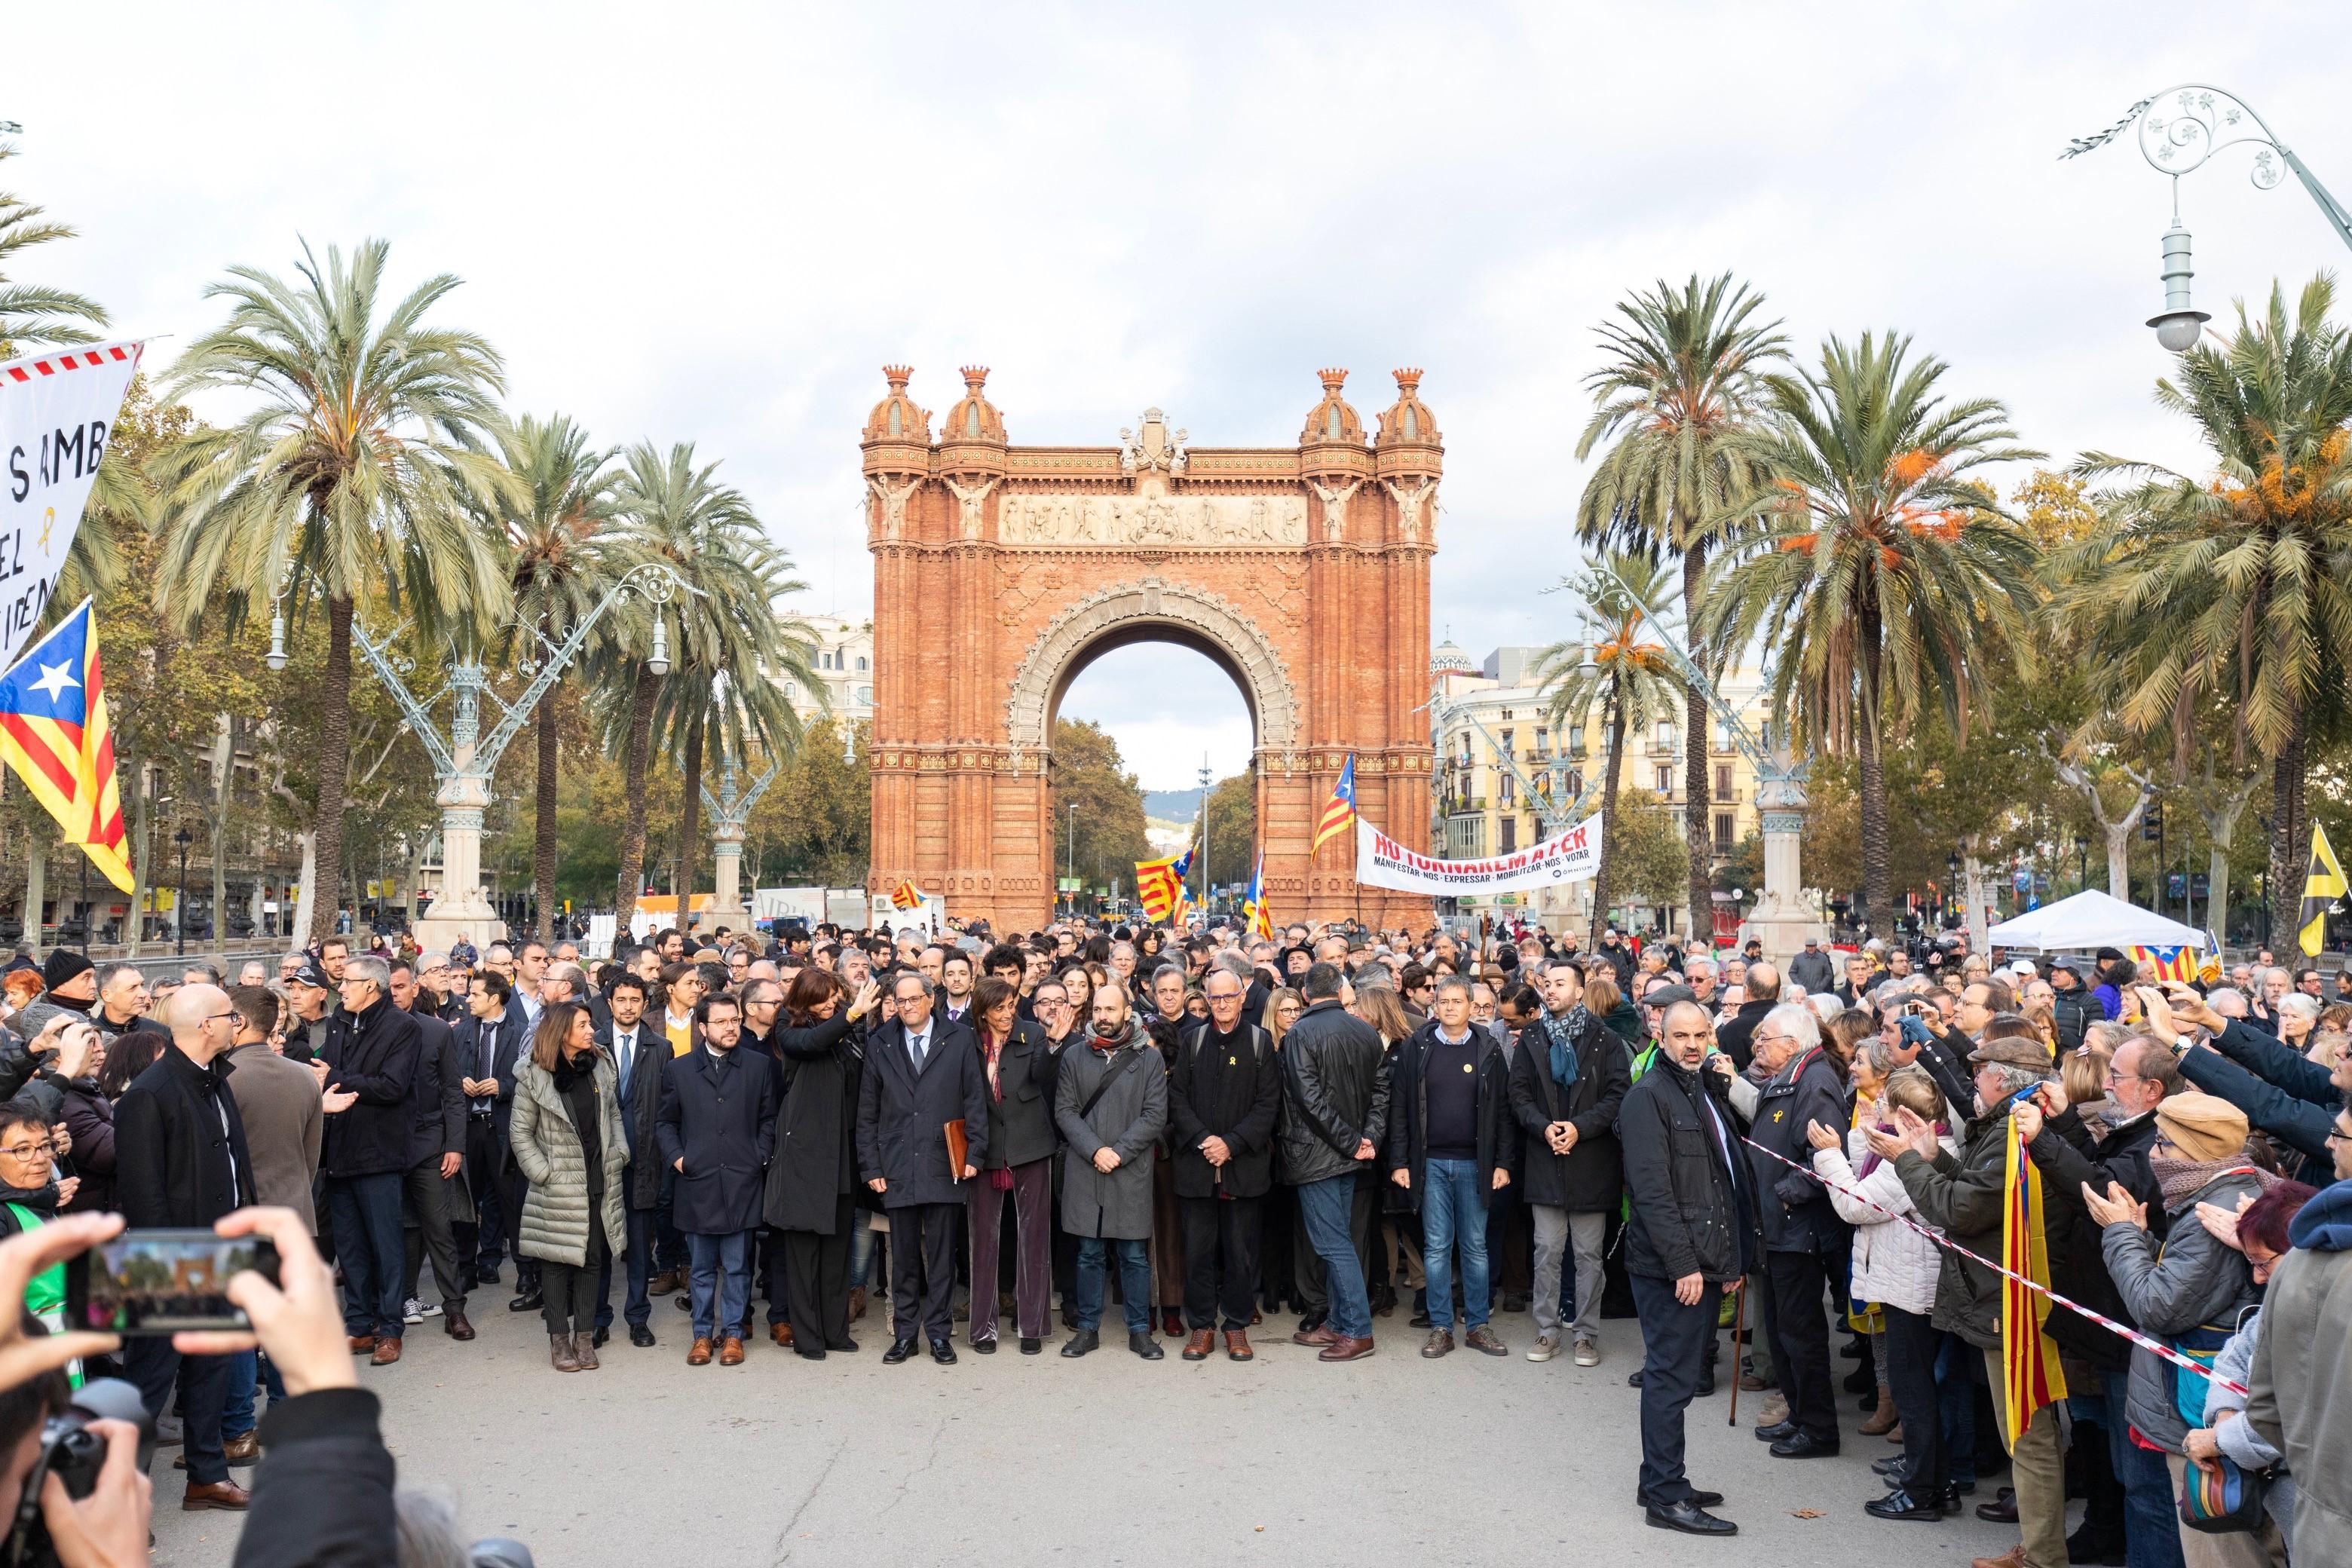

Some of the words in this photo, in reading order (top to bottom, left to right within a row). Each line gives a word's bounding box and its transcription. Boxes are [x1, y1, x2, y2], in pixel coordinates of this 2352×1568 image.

[39, 421, 106, 488] AMB
[1374, 856, 1439, 881] MANIFESTAR-NOS
[1444, 874, 1491, 884] EXPRESSAR
[1496, 857, 1561, 881] MOBILITZAR-NOS
[1565, 849, 1590, 862] VOTAR
[1532, 849, 1544, 863] A
[2029, 897, 2037, 906] P
